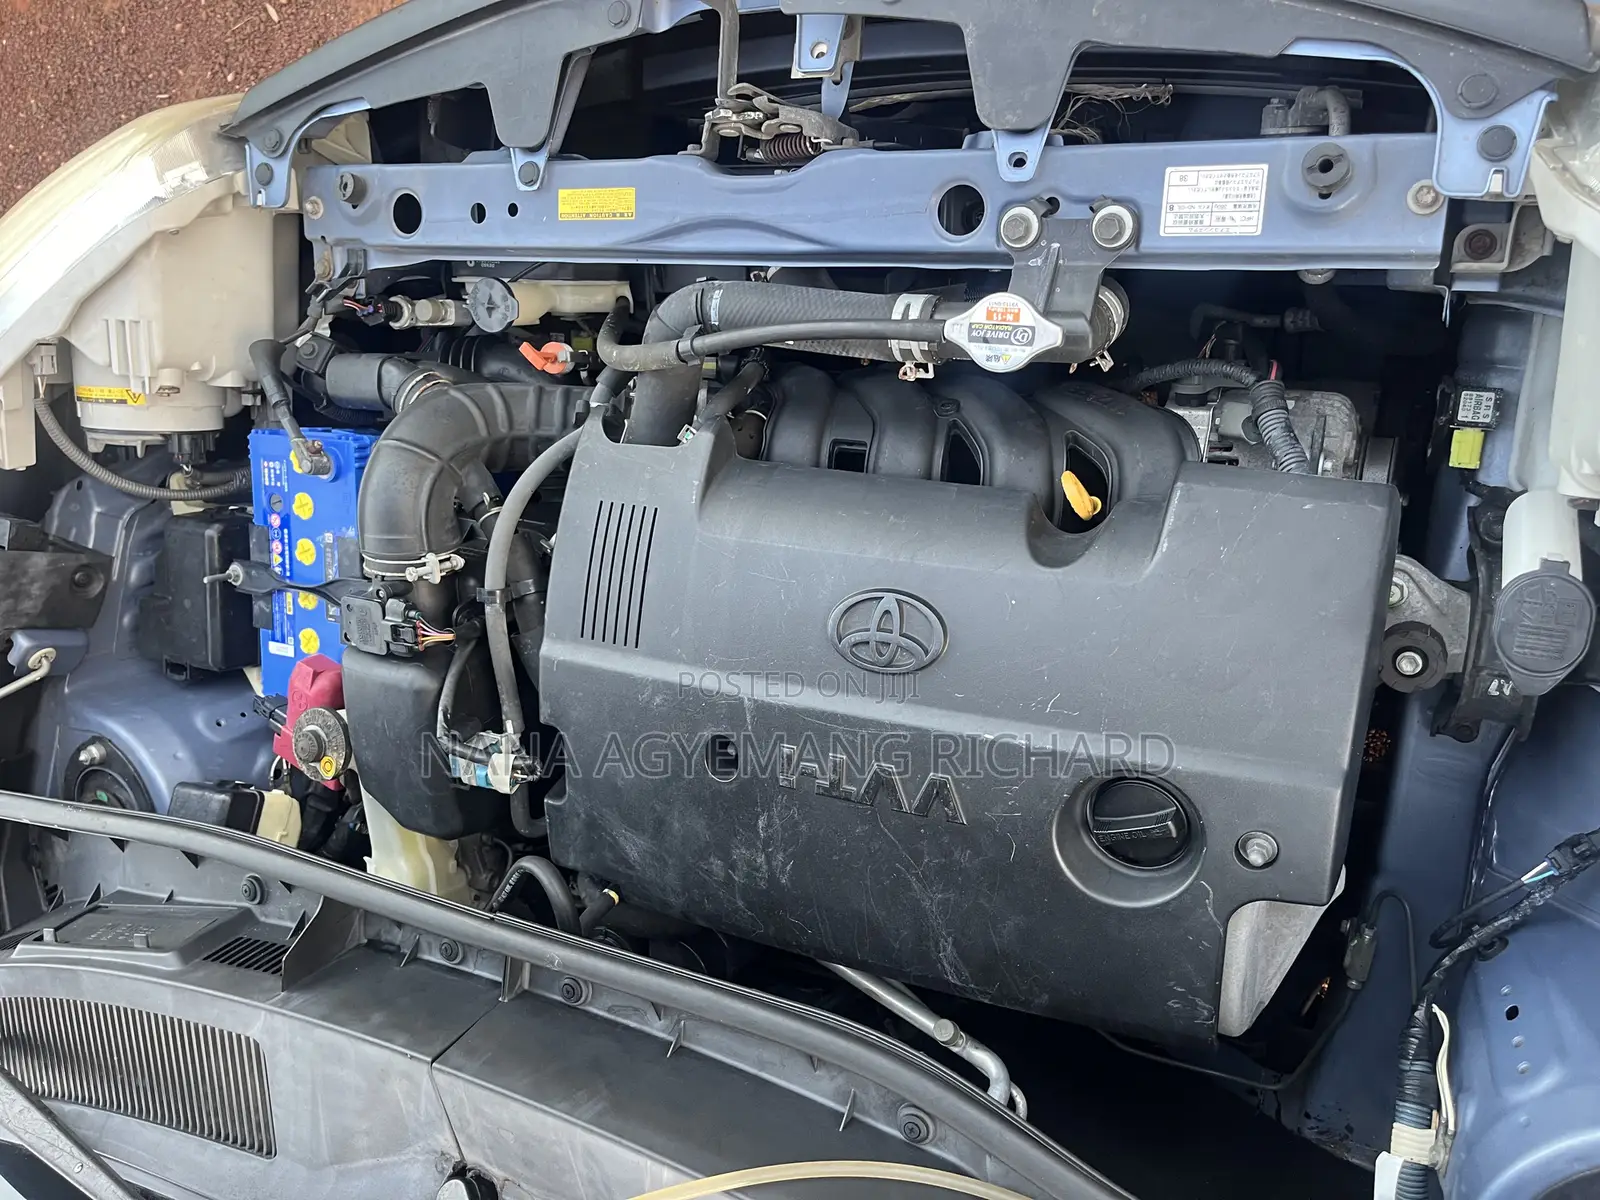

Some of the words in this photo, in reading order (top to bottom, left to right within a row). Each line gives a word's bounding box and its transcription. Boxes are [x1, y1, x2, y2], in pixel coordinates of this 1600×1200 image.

[971, 329, 986, 338] JOY
[986, 330, 1010, 339] DRIVE
[1472, 394, 1483, 420] AIRBAG
[1098, 832, 1131, 842] ENGINE
[1132, 830, 1147, 839] OIL
